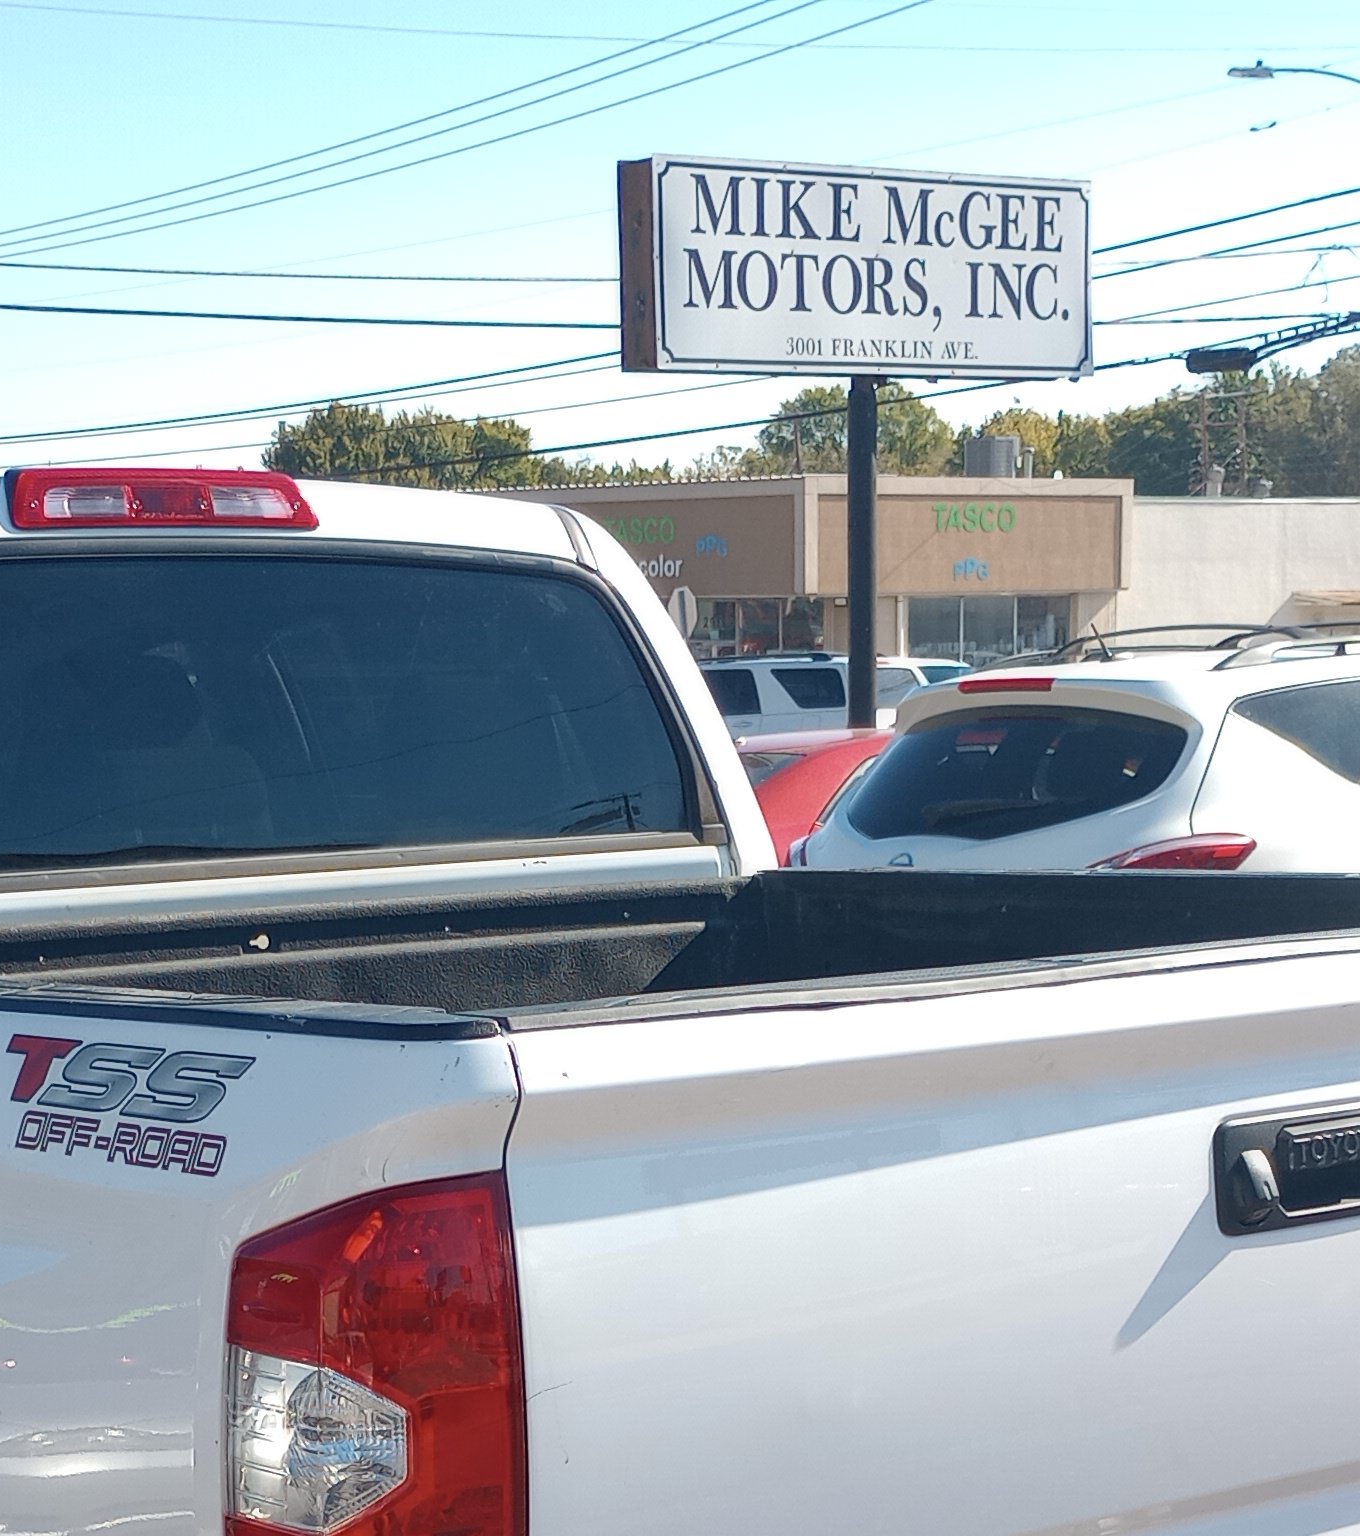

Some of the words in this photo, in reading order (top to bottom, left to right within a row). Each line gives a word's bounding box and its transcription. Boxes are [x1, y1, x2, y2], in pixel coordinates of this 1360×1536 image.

[690, 174, 860, 242] MIKE
[884, 186, 1063, 253] McGEE
[683, 248, 942, 334] MOTORS,
[965, 262, 1070, 322] INC.
[785, 337, 824, 357] 3001
[831, 339, 934, 360] FRANKLIN
[940, 341, 980, 360] AVE.
[931, 503, 1017, 533] TASCO
[5, 1033, 257, 1124] TSS
[15, 1110, 228, 1178] OFF-ROAD
